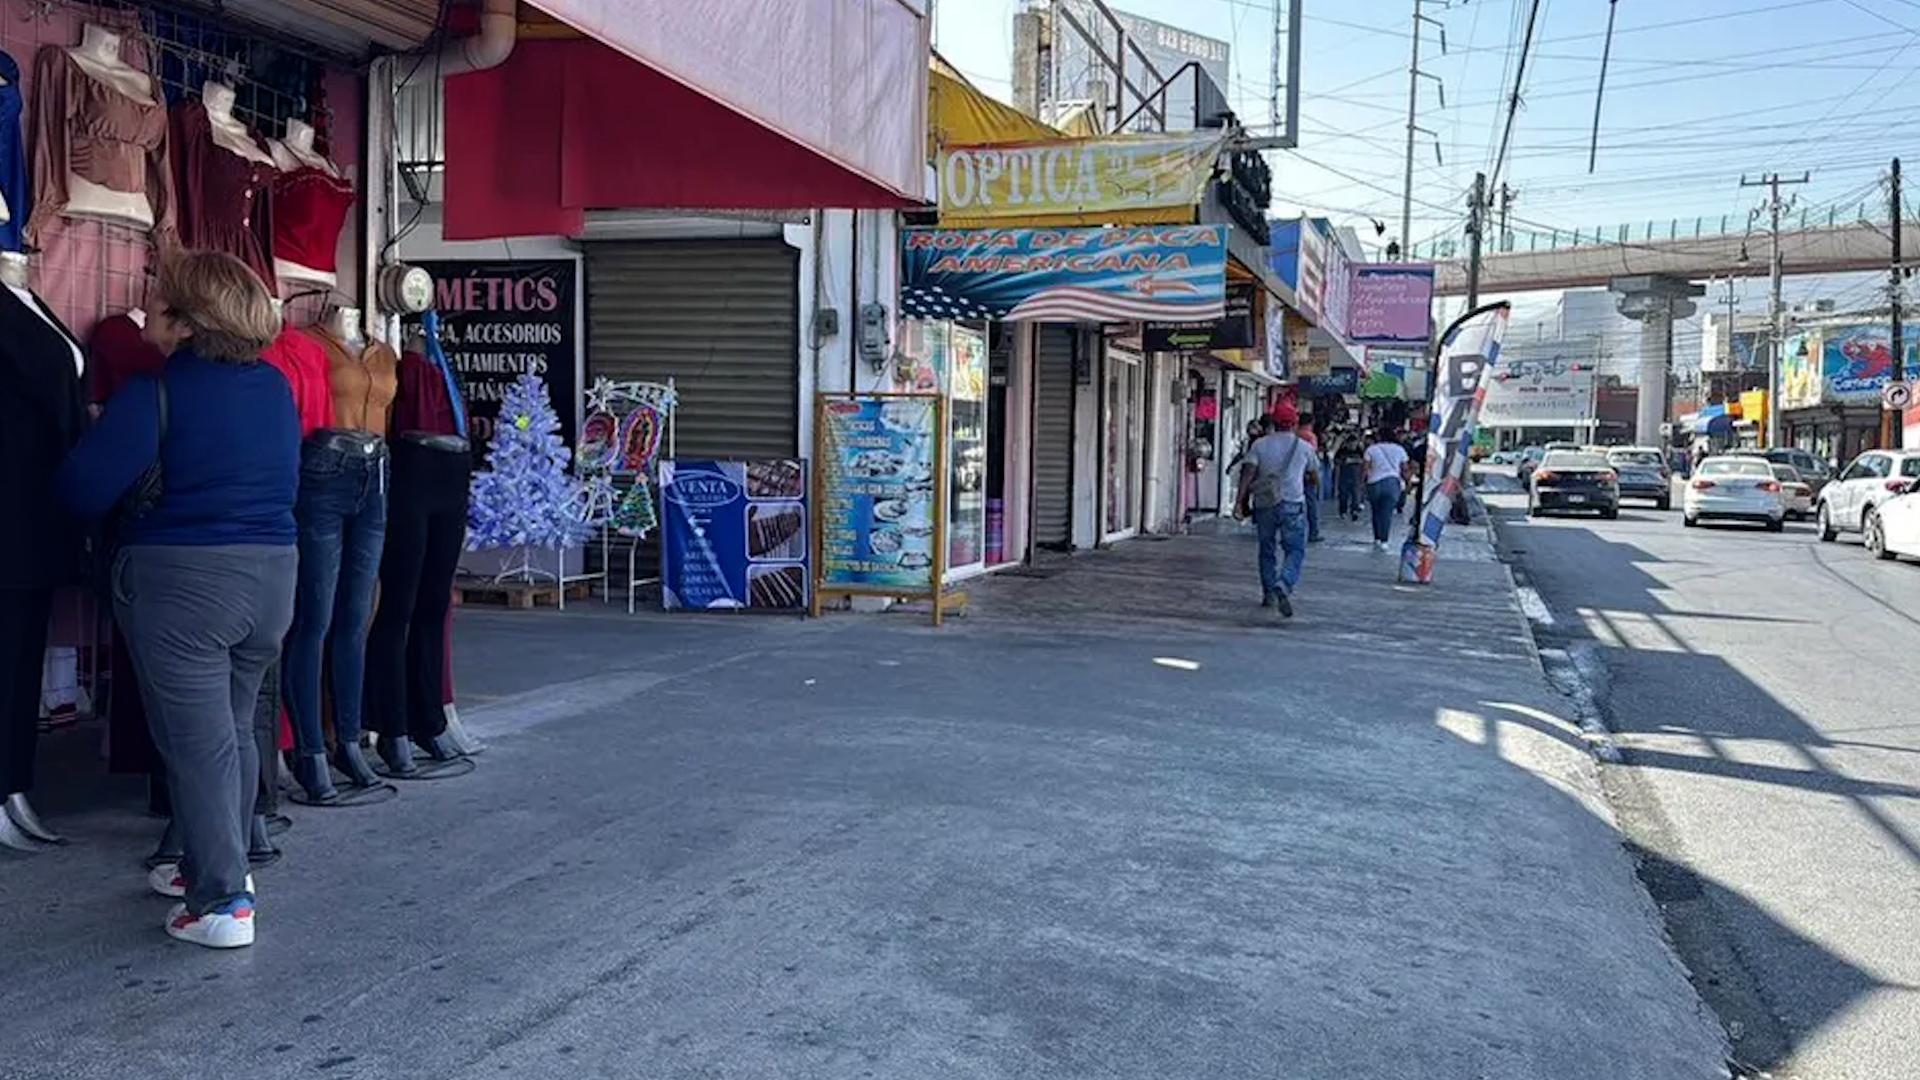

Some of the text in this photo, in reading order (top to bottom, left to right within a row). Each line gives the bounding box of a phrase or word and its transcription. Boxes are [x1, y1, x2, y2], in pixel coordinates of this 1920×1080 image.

[946, 146, 1101, 208] OPTICA
[905, 228, 1220, 250] ROPA DE PACA
[928, 252, 1190, 273] AMERICANA
[434, 270, 558, 312] MÉTICS
[463, 322, 561, 345] ACCESORIOS
[678, 480, 728, 493] VENTA
